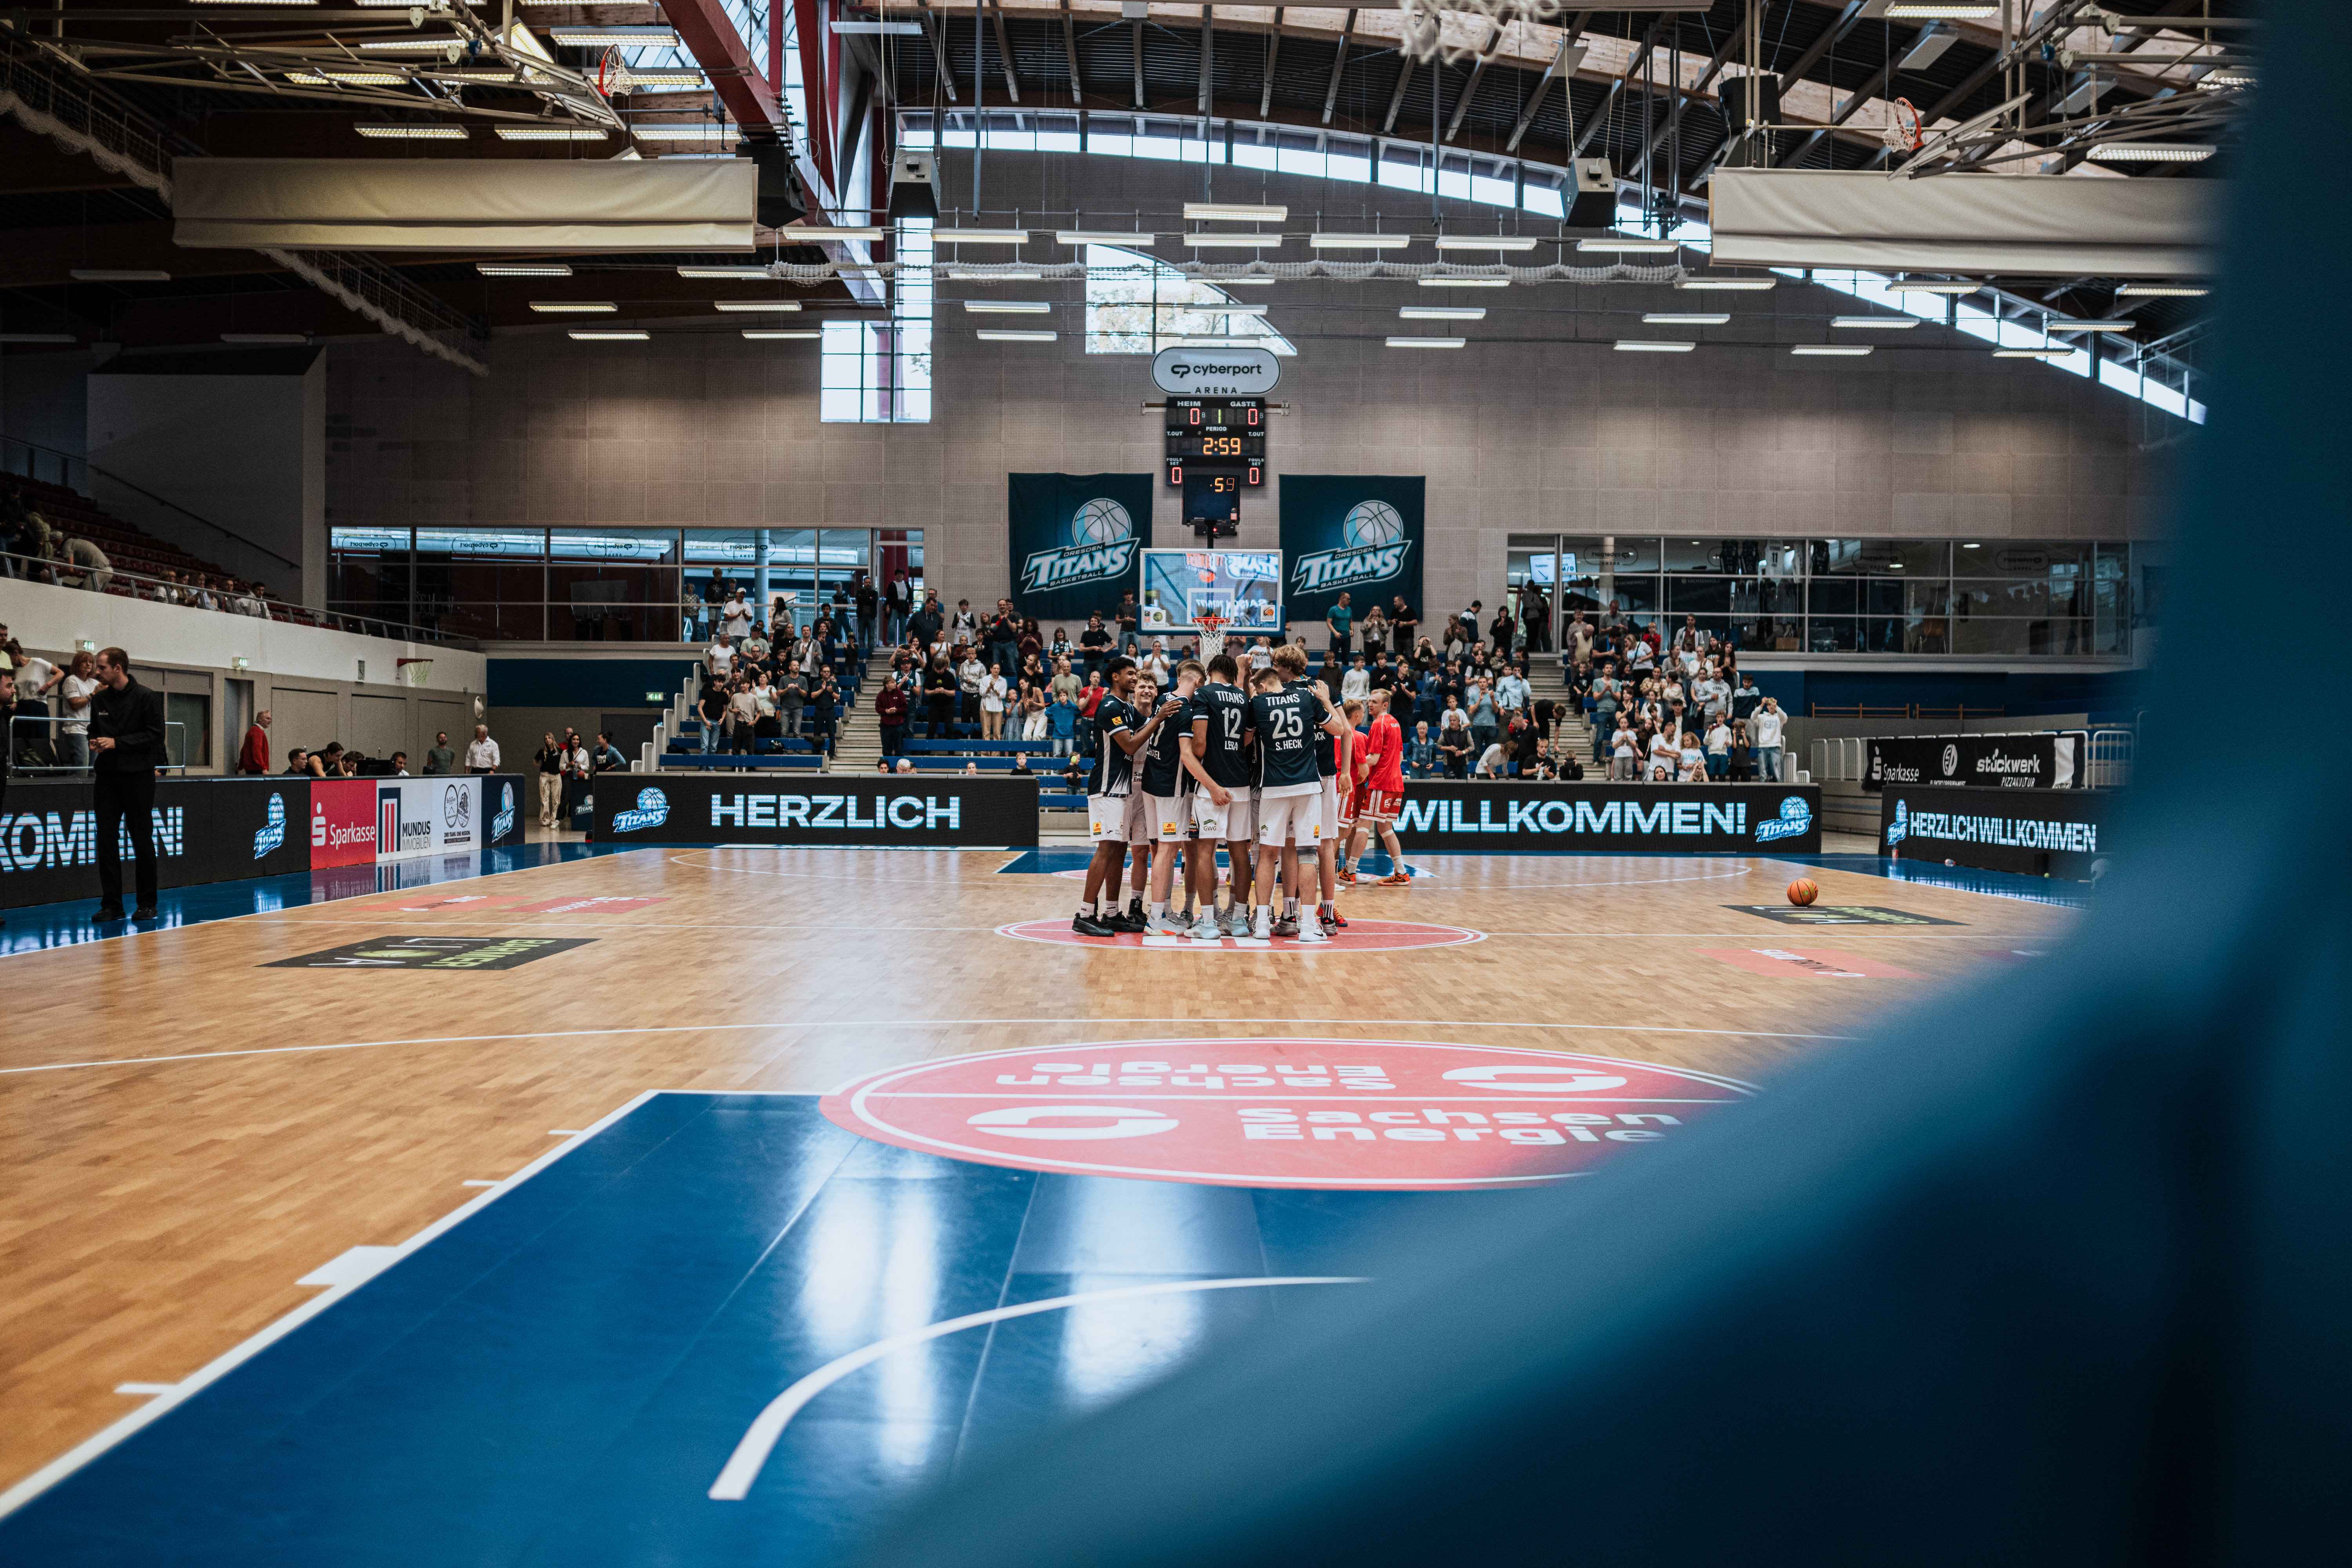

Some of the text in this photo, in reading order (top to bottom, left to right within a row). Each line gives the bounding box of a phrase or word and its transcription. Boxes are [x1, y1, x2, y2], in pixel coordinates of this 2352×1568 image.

[1193, 363, 1261, 376] cyberport
[1190, 408, 1200, 425] 0
[1218, 409, 1221, 424] 1
[1248, 408, 1258, 425] 0
[1203, 437, 1241, 455] 2:59
[1172, 467, 1181, 483] 0
[1249, 467, 1259, 485] 0
[1063, 545, 1103, 557] DRESDEN
[1335, 547, 1374, 559] DRESDEN
[1028, 544, 1132, 587] TITANS
[1298, 546, 1403, 588] TITANS
[1050, 571, 1103, 586] BASKETBALL
[1320, 573, 1374, 588] BASKETBALL
[1215, 691, 1245, 704] TITANS
[1266, 693, 1300, 706] TITANS
[1222, 707, 1241, 739] 12
[1270, 707, 1303, 739] 25
[1884, 763, 1919, 784] Sparkasse
[2001, 776, 2036, 788] PIZZAKULTUR
[711, 794, 960, 829] HERZLICH
[1393, 800, 1808, 837] WILLKOMMEN! TITANS
[402, 821, 430, 837] MUNDUS
[493, 810, 513, 838] TITANS
[1909, 811, 1977, 842] HERZLICH
[330, 822, 375, 850] Sparkasse
[402, 837, 430, 851] IMMOBILIEN
[421, 939, 557, 967] BARMER
[1032, 1061, 1387, 1078] Energie
[996, 1074, 1397, 1090] Sachsen
[1237, 1108, 1684, 1126] Sachsen
[1242, 1123, 1669, 1146] Energie
